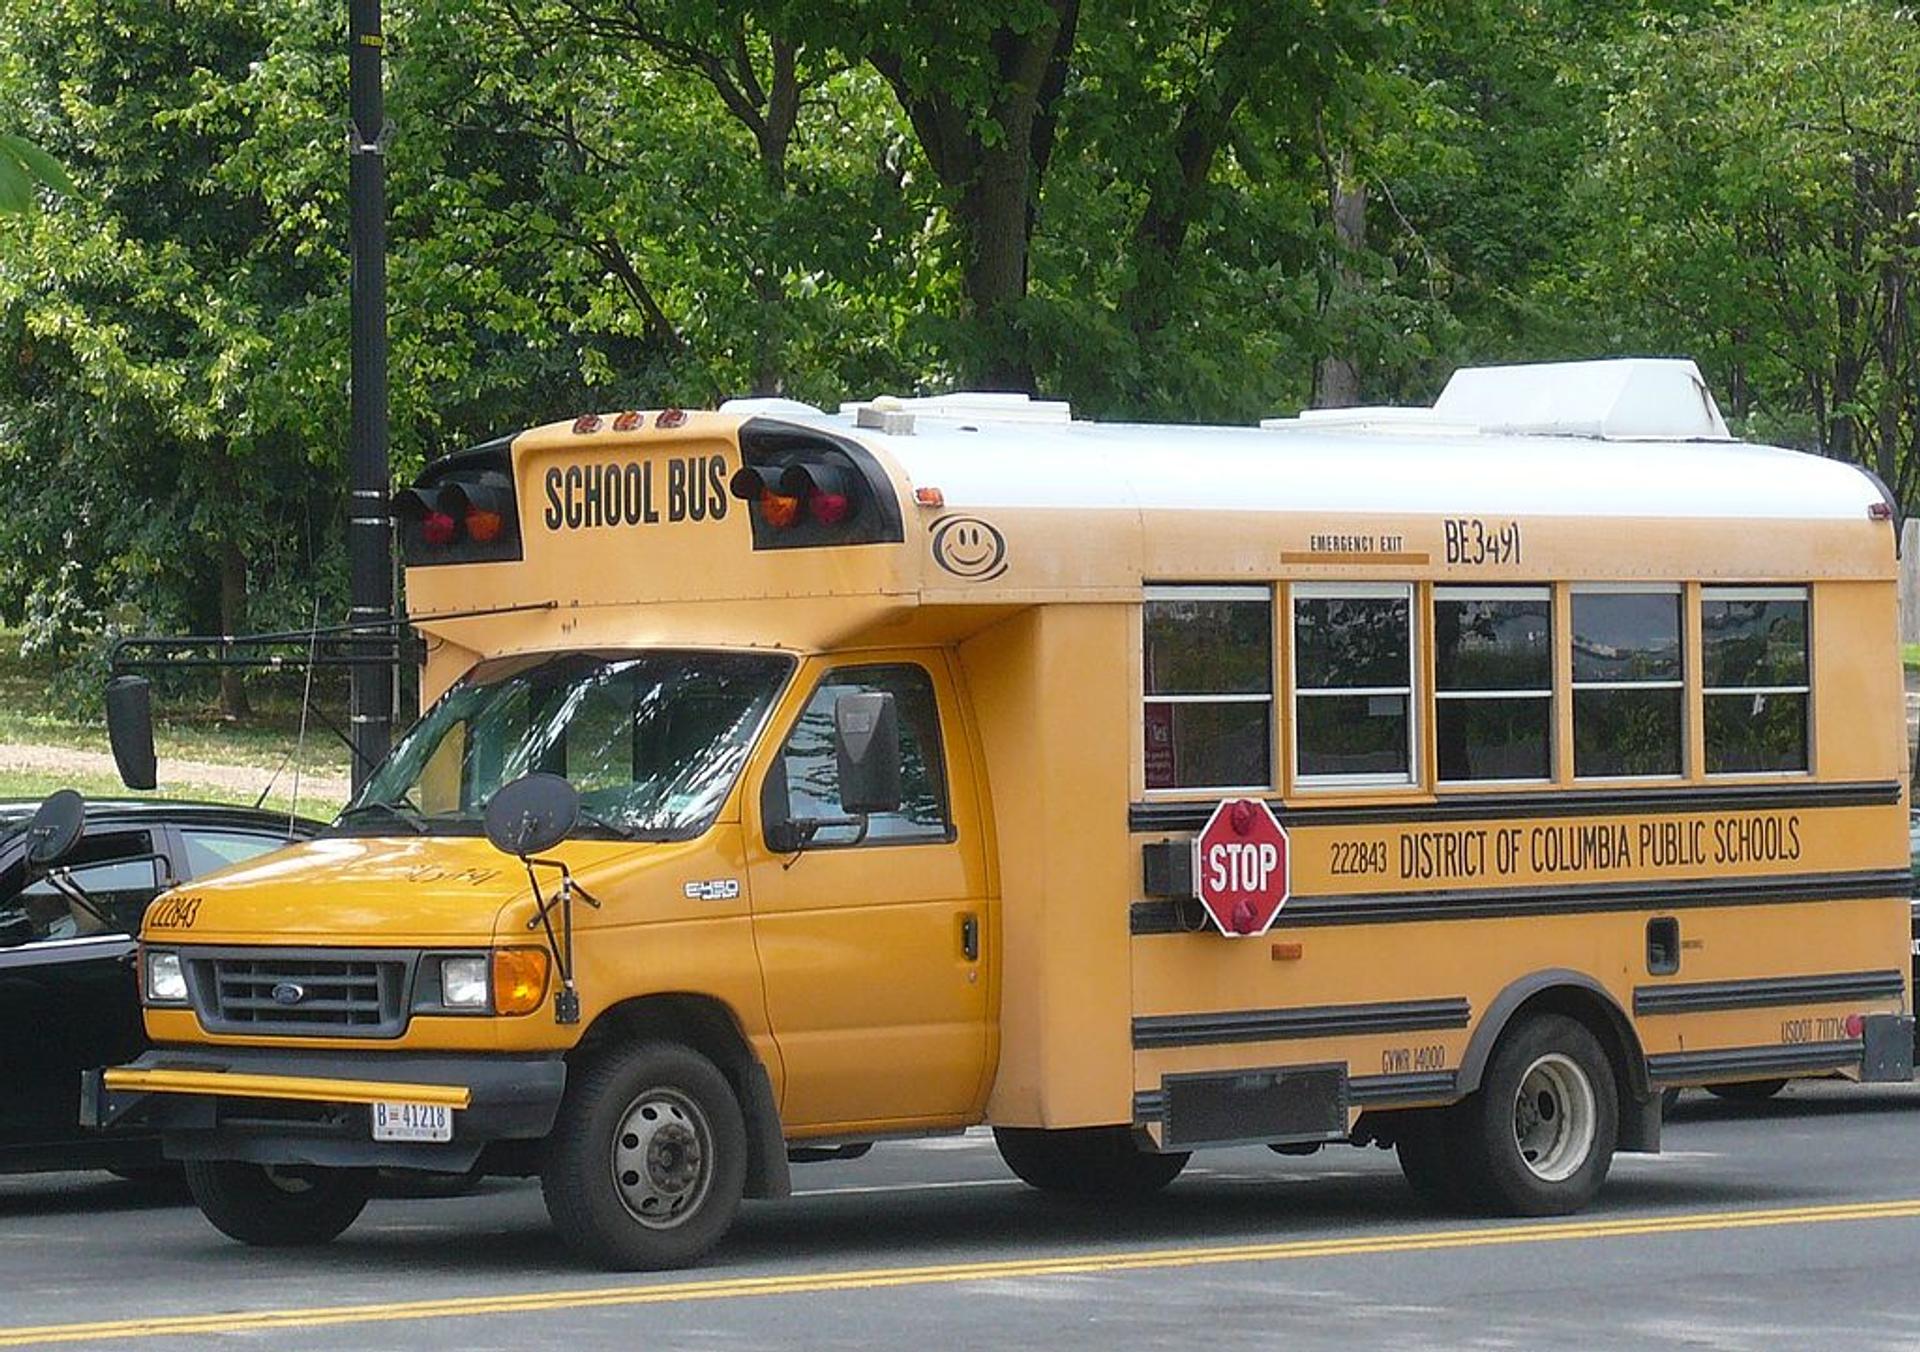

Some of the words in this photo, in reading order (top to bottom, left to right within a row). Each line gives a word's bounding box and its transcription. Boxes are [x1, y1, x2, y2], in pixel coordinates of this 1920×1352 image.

[545, 465, 660, 531] SCHOOL
[668, 453, 727, 523] BUS
[1310, 534, 1375, 553] EMERGENCY
[1380, 535, 1403, 553] EXIT
[1444, 518, 1521, 565] BE3491
[1330, 839, 1387, 876] 222843
[1400, 830, 1488, 880] DISTRICT
[1496, 828, 1523, 875] OF
[1531, 824, 1632, 873] COLUMBIA
[1639, 819, 1707, 868] PUBLIC
[1713, 814, 1800, 864] SCHOOLS
[1209, 842, 1278, 893] STOP
[150, 897, 202, 928] 222843
[1781, 1018, 1812, 1043] USDOT
[1382, 1048, 1410, 1074] GVWR
[1413, 1045, 1446, 1073] 14000
[377, 1102, 387, 1127] B
[403, 1103, 446, 1129] 41218
